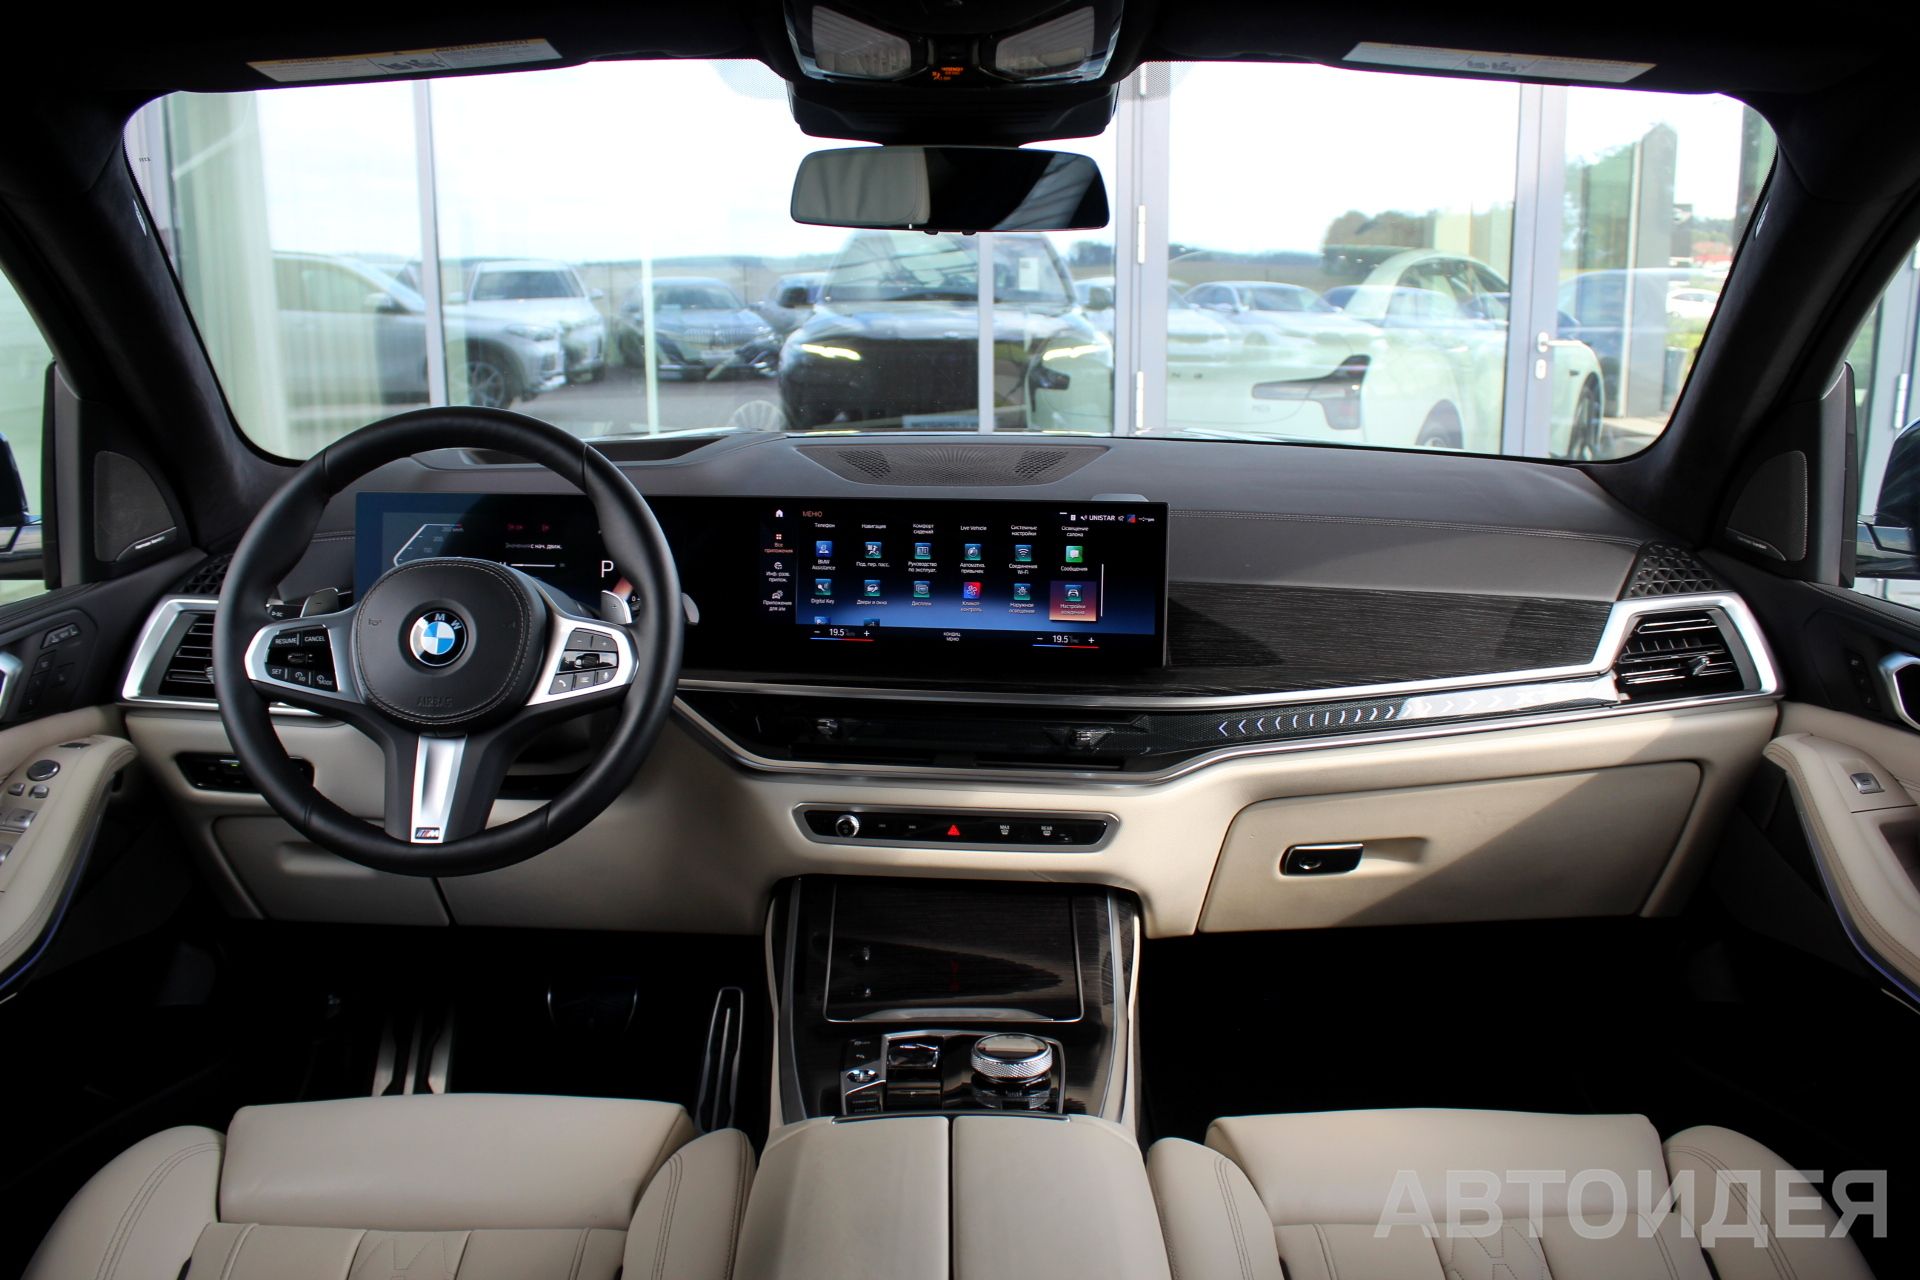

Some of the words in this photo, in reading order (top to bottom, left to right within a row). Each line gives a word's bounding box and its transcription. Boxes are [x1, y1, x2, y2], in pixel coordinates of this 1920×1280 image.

[601, 560, 614, 578] P
[829, 628, 845, 636] 19.5
[1052, 635, 1069, 643] 19.5
